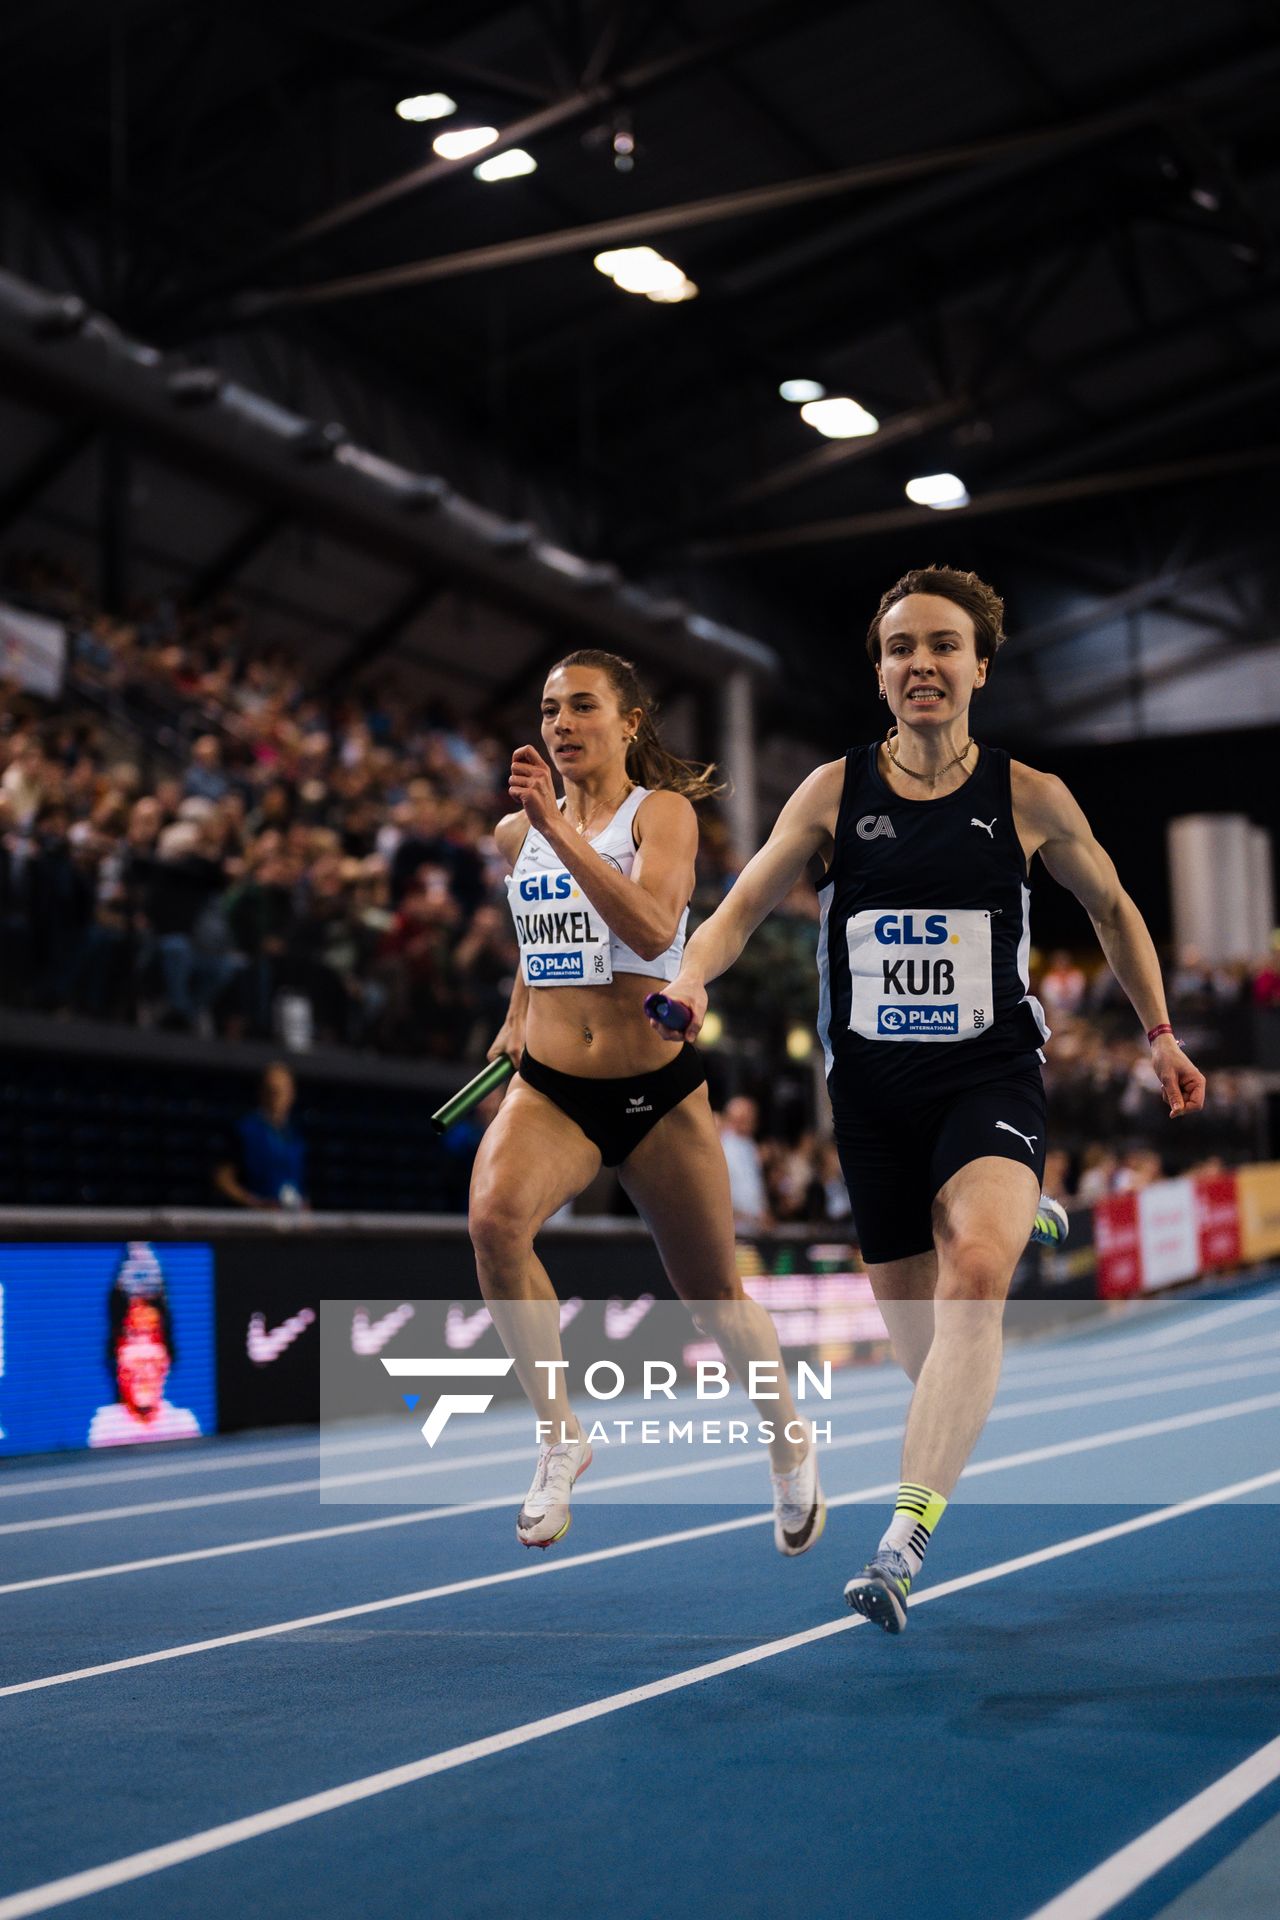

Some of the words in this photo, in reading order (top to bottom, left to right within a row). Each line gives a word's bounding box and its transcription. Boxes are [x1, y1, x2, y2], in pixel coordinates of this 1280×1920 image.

[546, 957, 580, 970] PLAN
[593, 954, 605, 973] 292
[909, 1010, 955, 1024] PLAN
[973, 1008, 985, 1029] 286
[625, 1104, 653, 1114] erima
